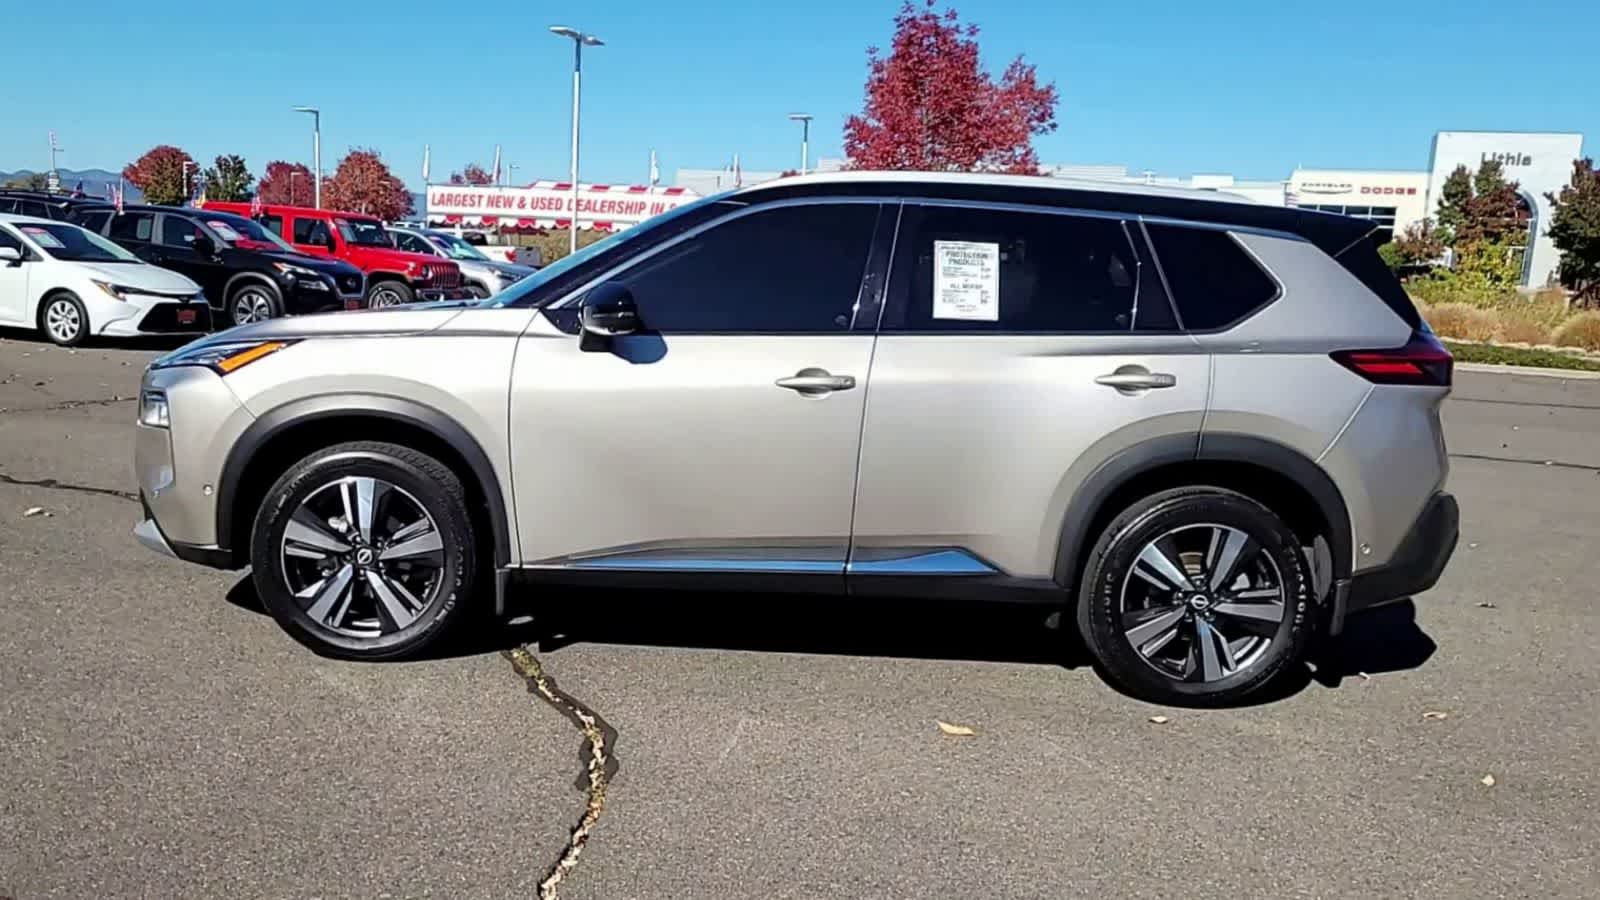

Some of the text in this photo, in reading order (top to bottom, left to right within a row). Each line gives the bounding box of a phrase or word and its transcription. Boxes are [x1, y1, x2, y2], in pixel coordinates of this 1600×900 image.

[431, 191, 485, 208] LARGEST
[486, 195, 514, 209] NEW
[517, 197, 527, 210] &
[530, 197, 563, 211] USED
[649, 202, 665, 214] IN
